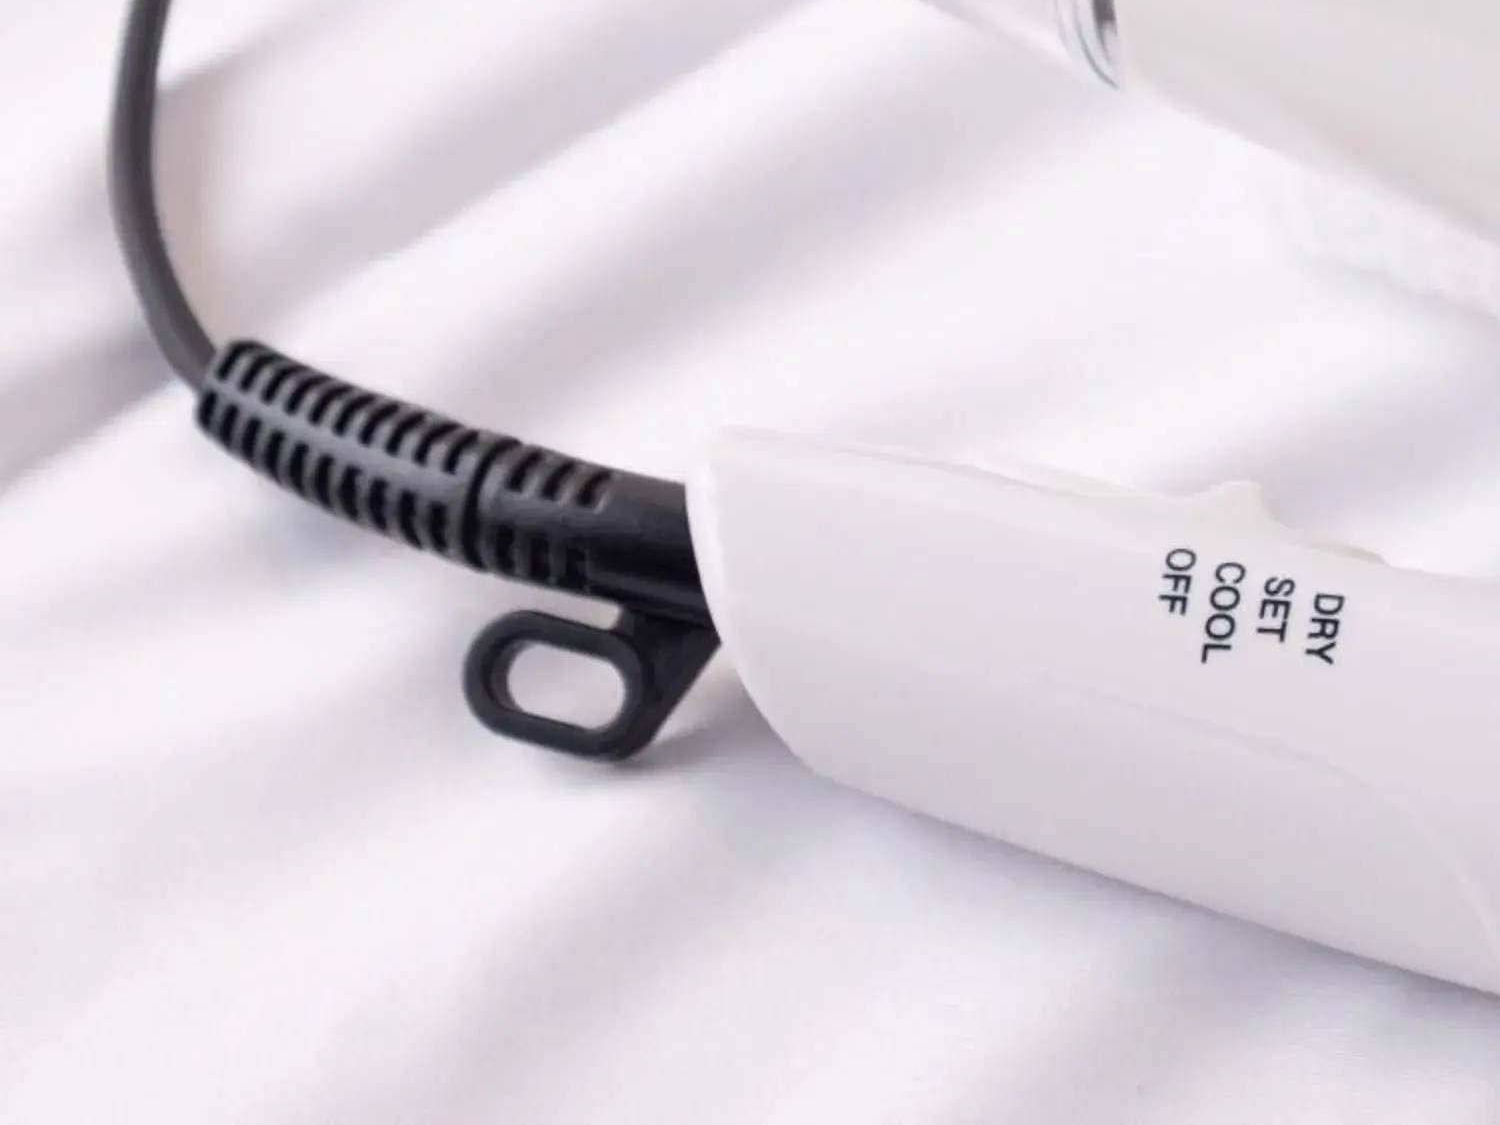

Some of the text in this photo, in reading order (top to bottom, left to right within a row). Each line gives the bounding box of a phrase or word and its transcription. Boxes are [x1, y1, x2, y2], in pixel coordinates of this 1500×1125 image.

[1157, 547, 1198, 616] OFF
[1200, 561, 1247, 665] COOL
[1255, 575, 1296, 644] SET
[1304, 592, 1346, 666] DRY
